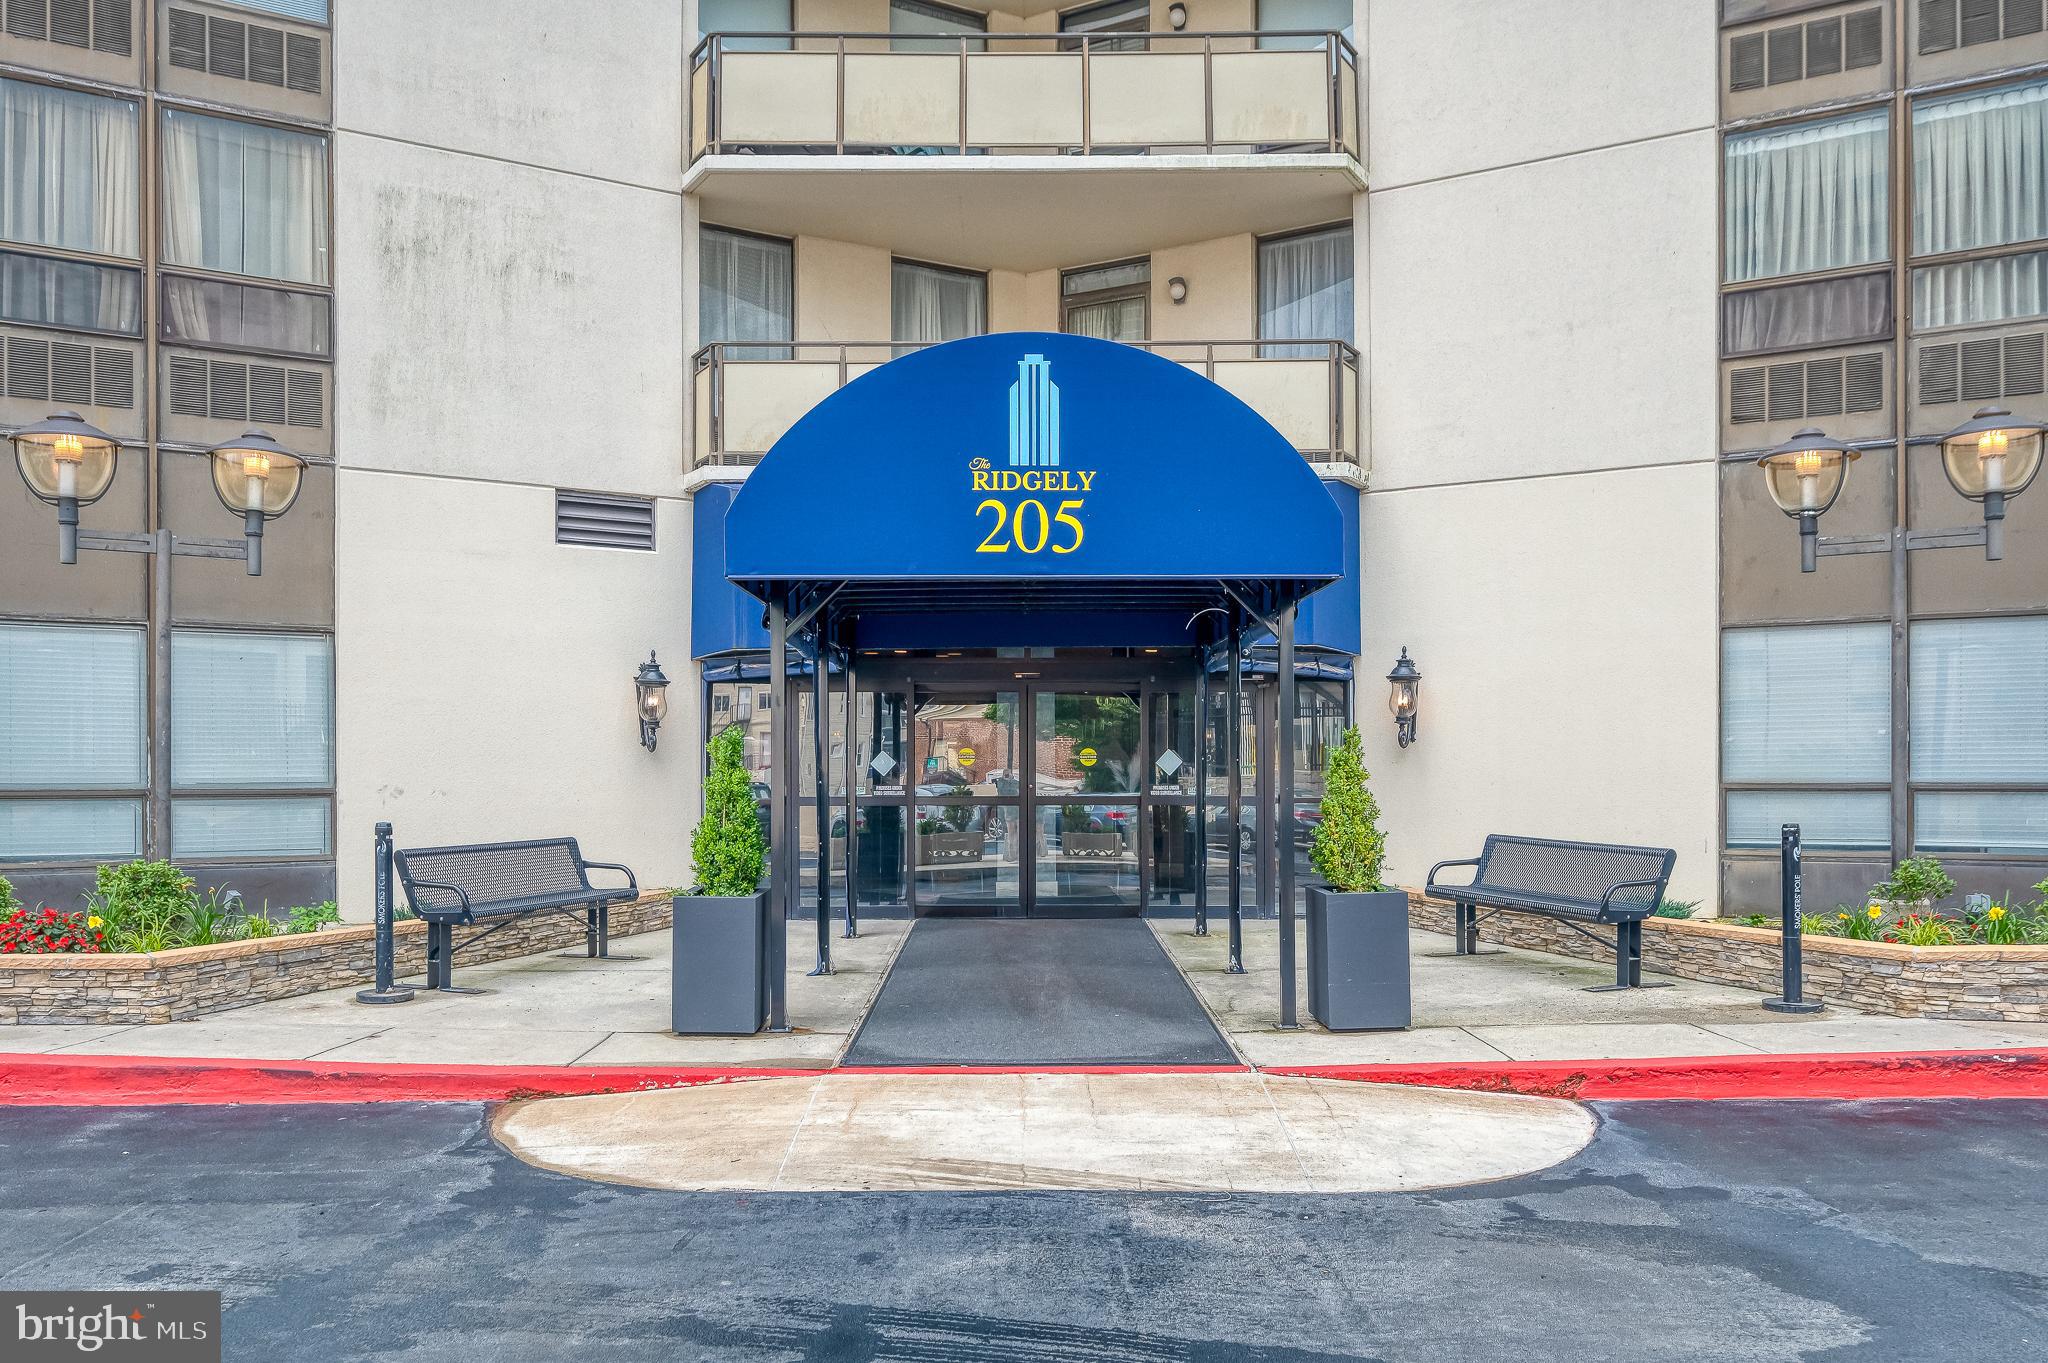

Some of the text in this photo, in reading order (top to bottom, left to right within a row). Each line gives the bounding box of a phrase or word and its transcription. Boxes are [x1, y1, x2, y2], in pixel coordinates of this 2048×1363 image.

[969, 457, 991, 470] The
[972, 470, 1096, 491] RIDGELY
[975, 498, 1085, 554] 205
